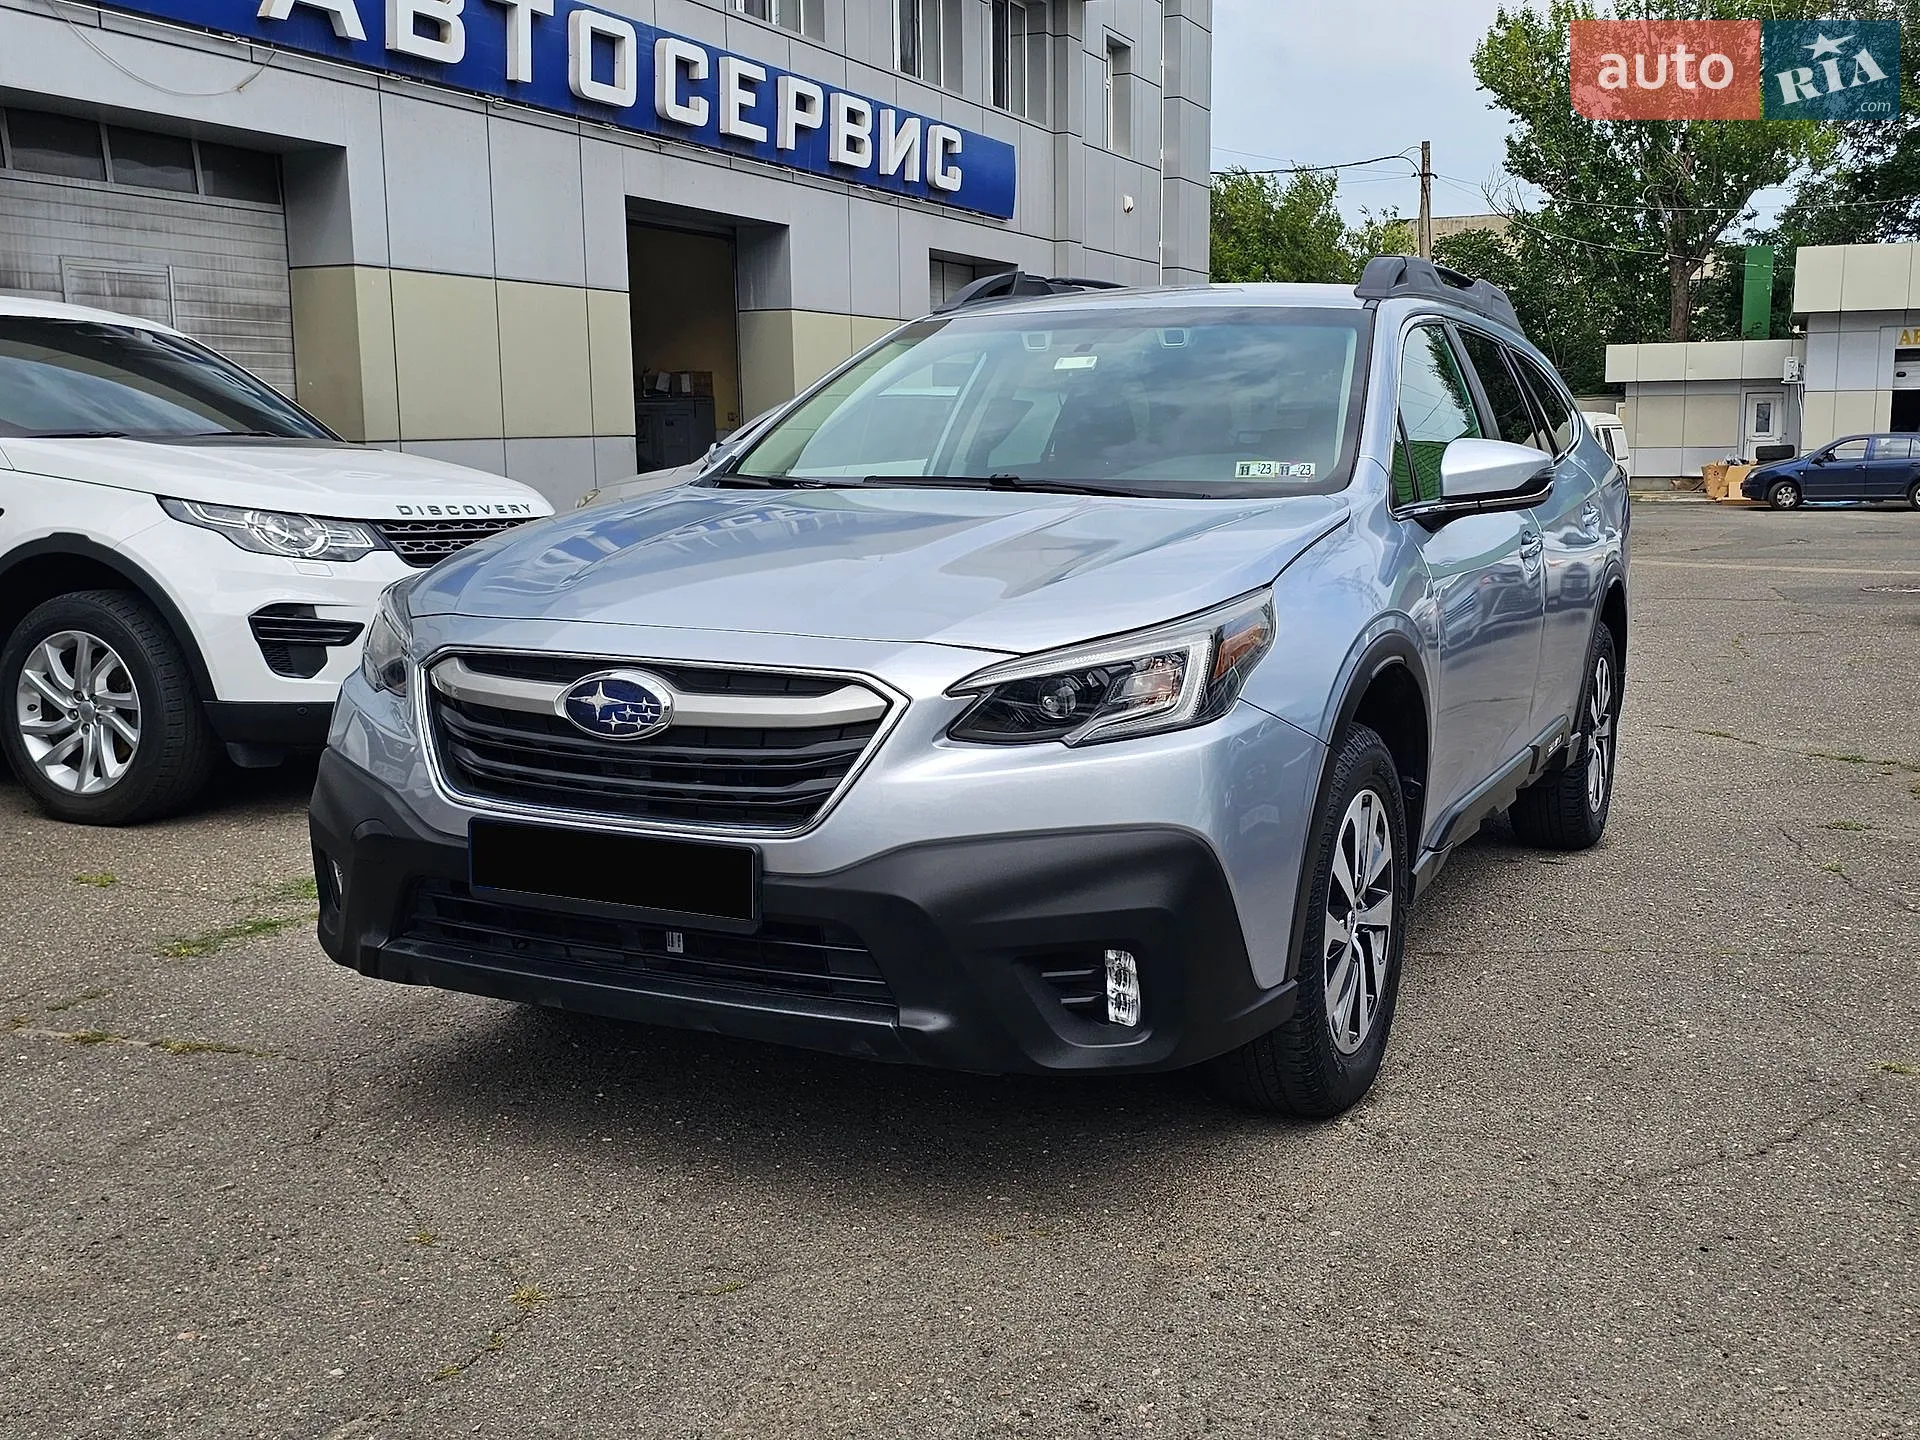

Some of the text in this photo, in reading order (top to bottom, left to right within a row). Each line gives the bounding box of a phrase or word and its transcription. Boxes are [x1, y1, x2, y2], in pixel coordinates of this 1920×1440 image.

[1260, 463, 1272, 475] 23
[1300, 464, 1311, 476] 23
[396, 504, 531, 516] DISCOVERY
